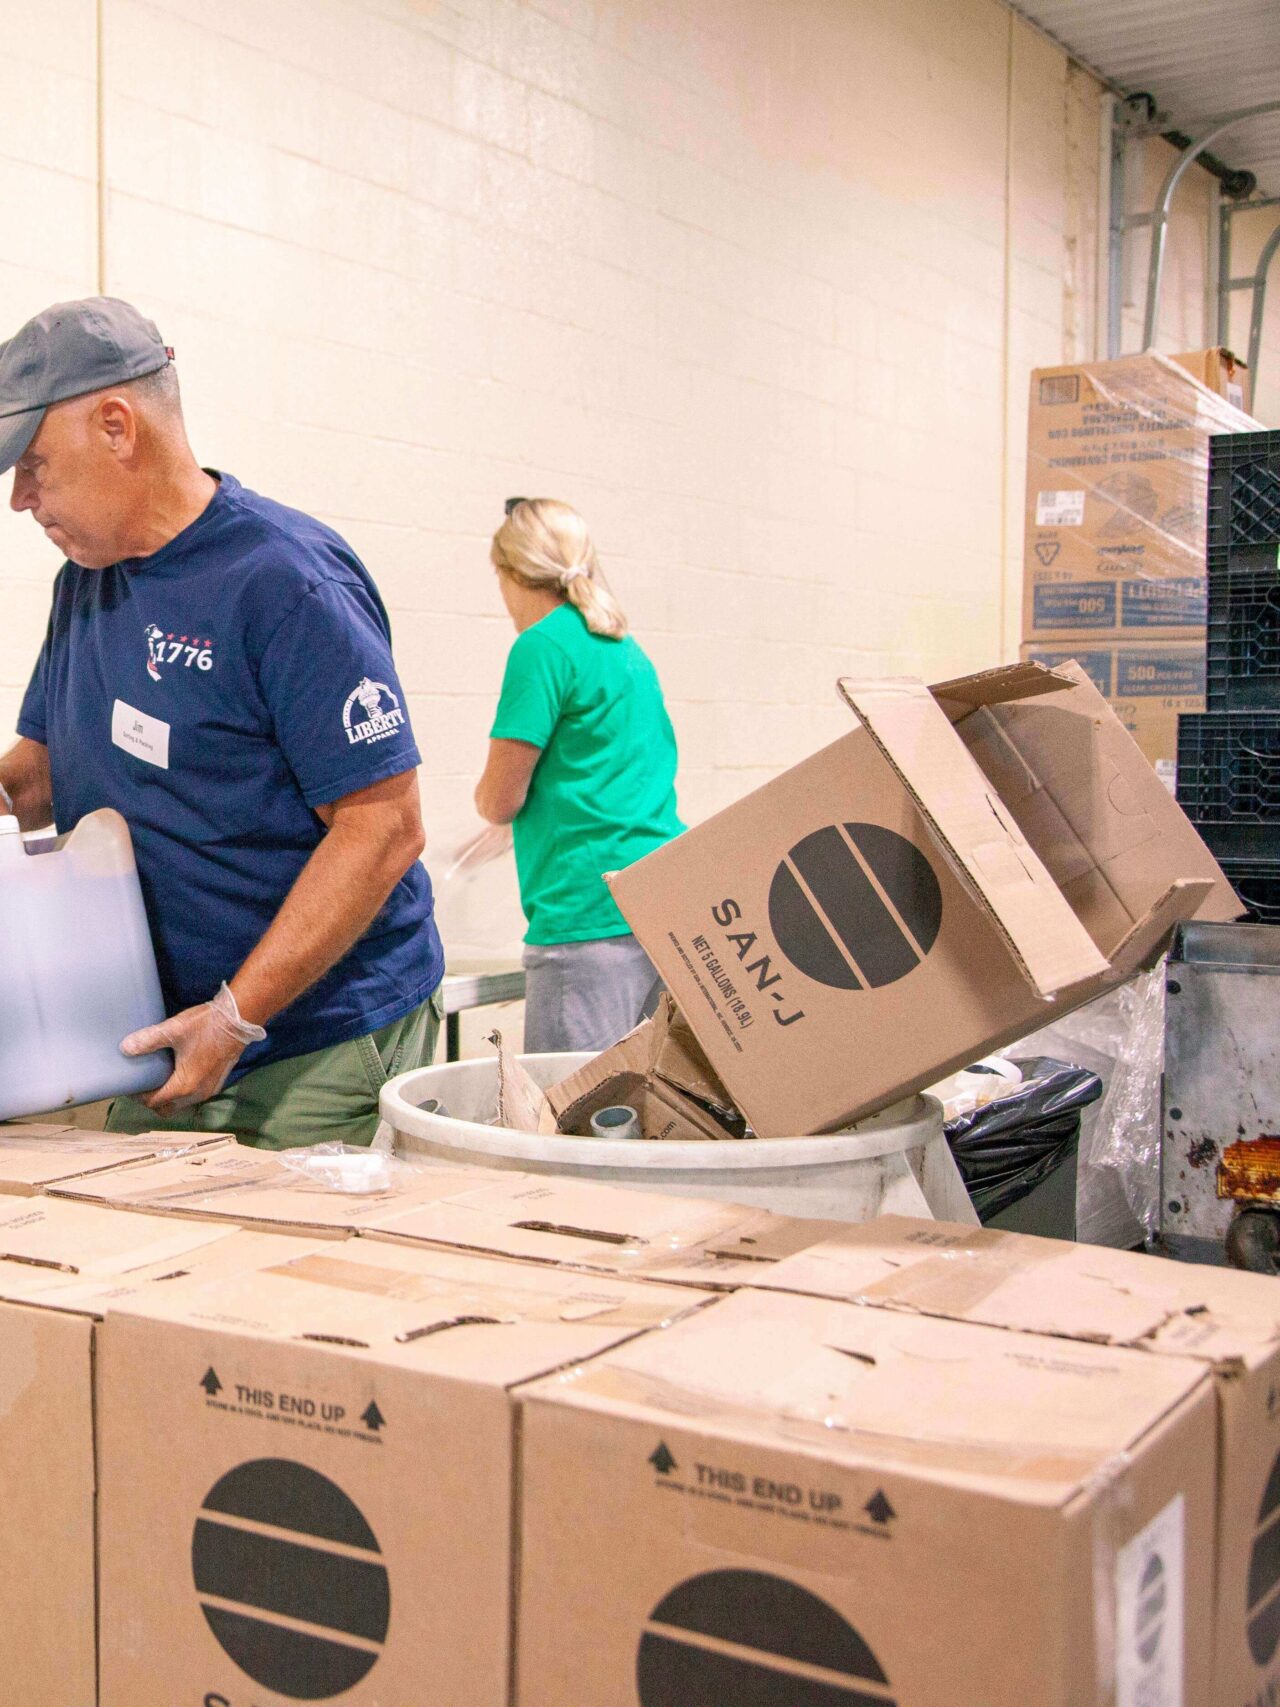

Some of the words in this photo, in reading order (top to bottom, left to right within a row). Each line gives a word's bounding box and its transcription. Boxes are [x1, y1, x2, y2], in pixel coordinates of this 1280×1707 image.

[156, 641, 213, 671] 1776
[1128, 665, 1155, 681] 500
[345, 708, 405, 744] LIBERTY
[691, 934, 708, 954] NET
[700, 950, 709, 961] 5
[706, 958, 737, 999] GALLONS
[726, 995, 755, 1030] (18.9L)
[712, 899, 805, 1027] SAN-J
[235, 1384, 274, 1409] THIS
[279, 1394, 315, 1417] END
[321, 1404, 345, 1422] UP
[695, 1463, 746, 1492] THIS
[752, 1476, 803, 1505] END
[809, 1489, 843, 1512] UP
